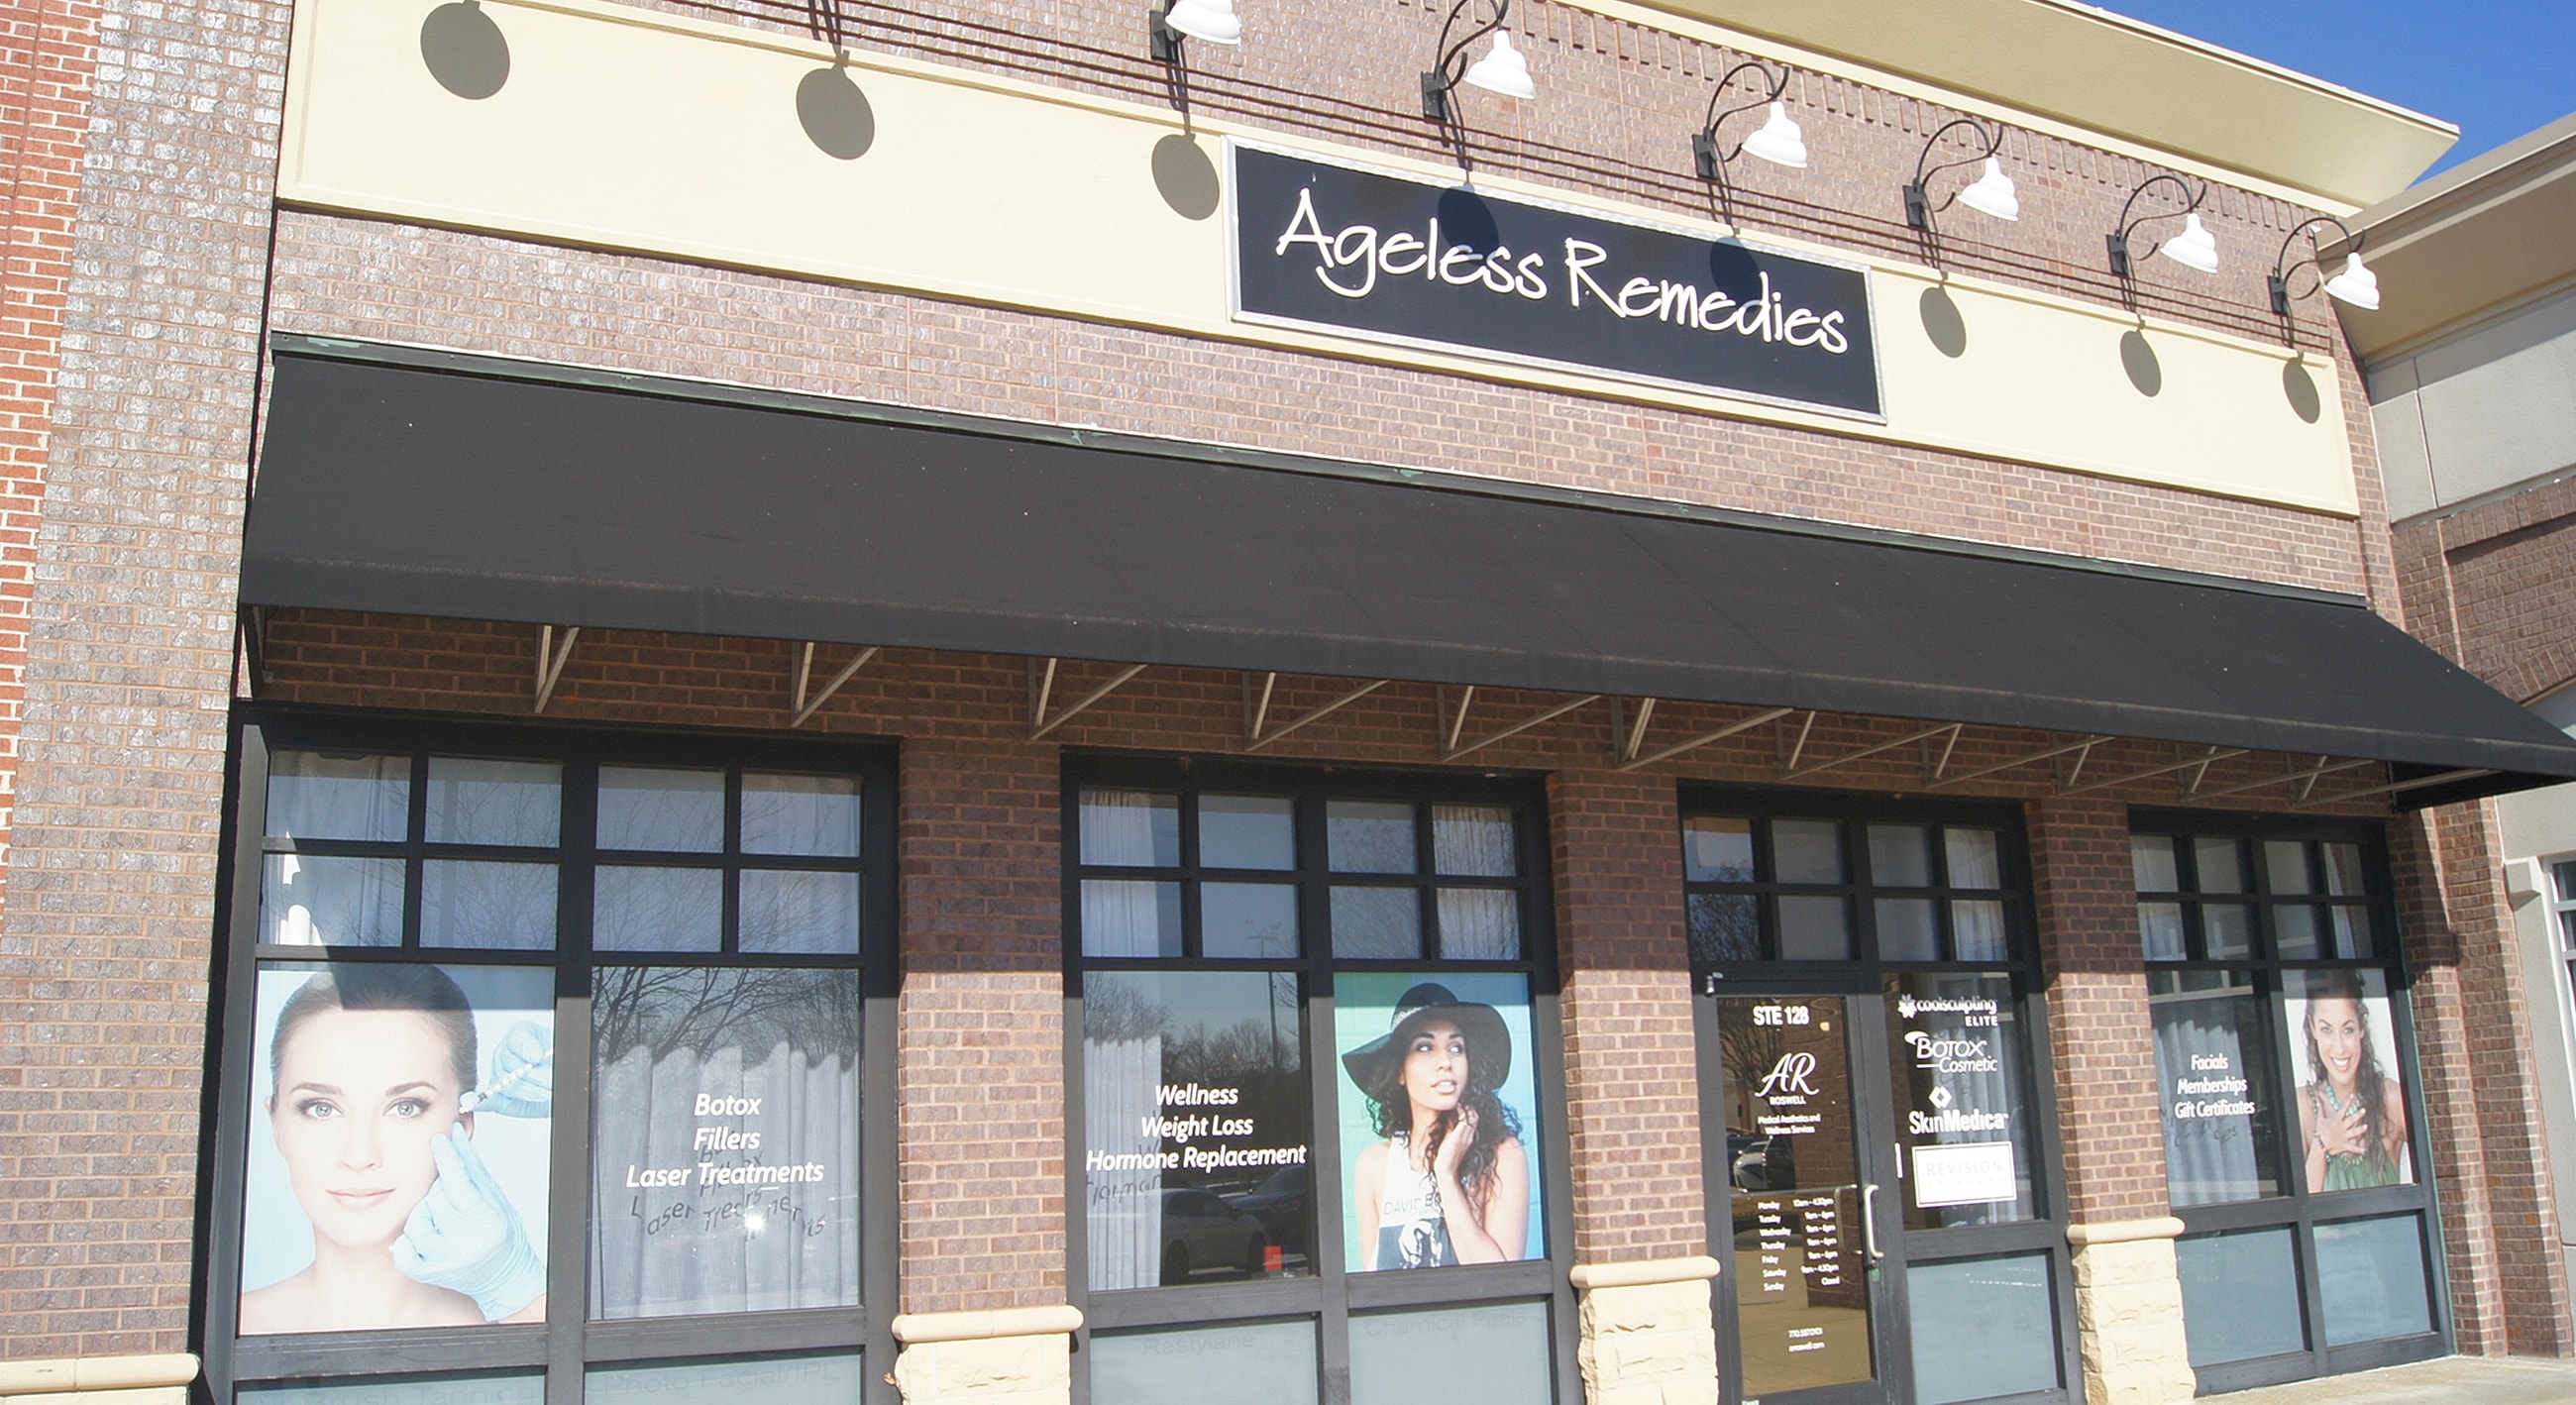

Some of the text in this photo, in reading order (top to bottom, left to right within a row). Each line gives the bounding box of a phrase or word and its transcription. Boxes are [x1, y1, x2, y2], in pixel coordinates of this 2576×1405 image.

[1276, 187, 1849, 354] Ageless Remedies
[1753, 1006, 1810, 1026] STE 128
[1916, 995, 1997, 1015] coolsculpting
[1965, 1016, 1998, 1027] ELITE
[1916, 1037, 1985, 1059] BOTOX
[1938, 1055, 1998, 1074] Cosmetic
[2191, 1052, 2228, 1071] Facials
[1755, 1052, 1820, 1098] AR
[2177, 1076, 2247, 1096] Memberships
[694, 1093, 762, 1116] Botox
[1155, 1084, 1238, 1106] Wellness
[1770, 1095, 1806, 1106] ROSWELL
[2175, 1099, 2256, 1119] Gift Certificates
[1140, 1115, 1253, 1142] Weight Loss
[1908, 1108, 2006, 1135] SkinMedica
[694, 1127, 761, 1150] Fillers
[1086, 1144, 1307, 1173] Hormone Replacement
[1926, 1159, 2004, 1177] REVISION
[626, 1164, 692, 1188] Laser
[697, 1161, 824, 1186] Treatments
[1365, 1309, 1527, 1338] Chemical Peels
[1142, 1333, 1255, 1355] Restylane
[604, 1373, 690, 1395] Photo
